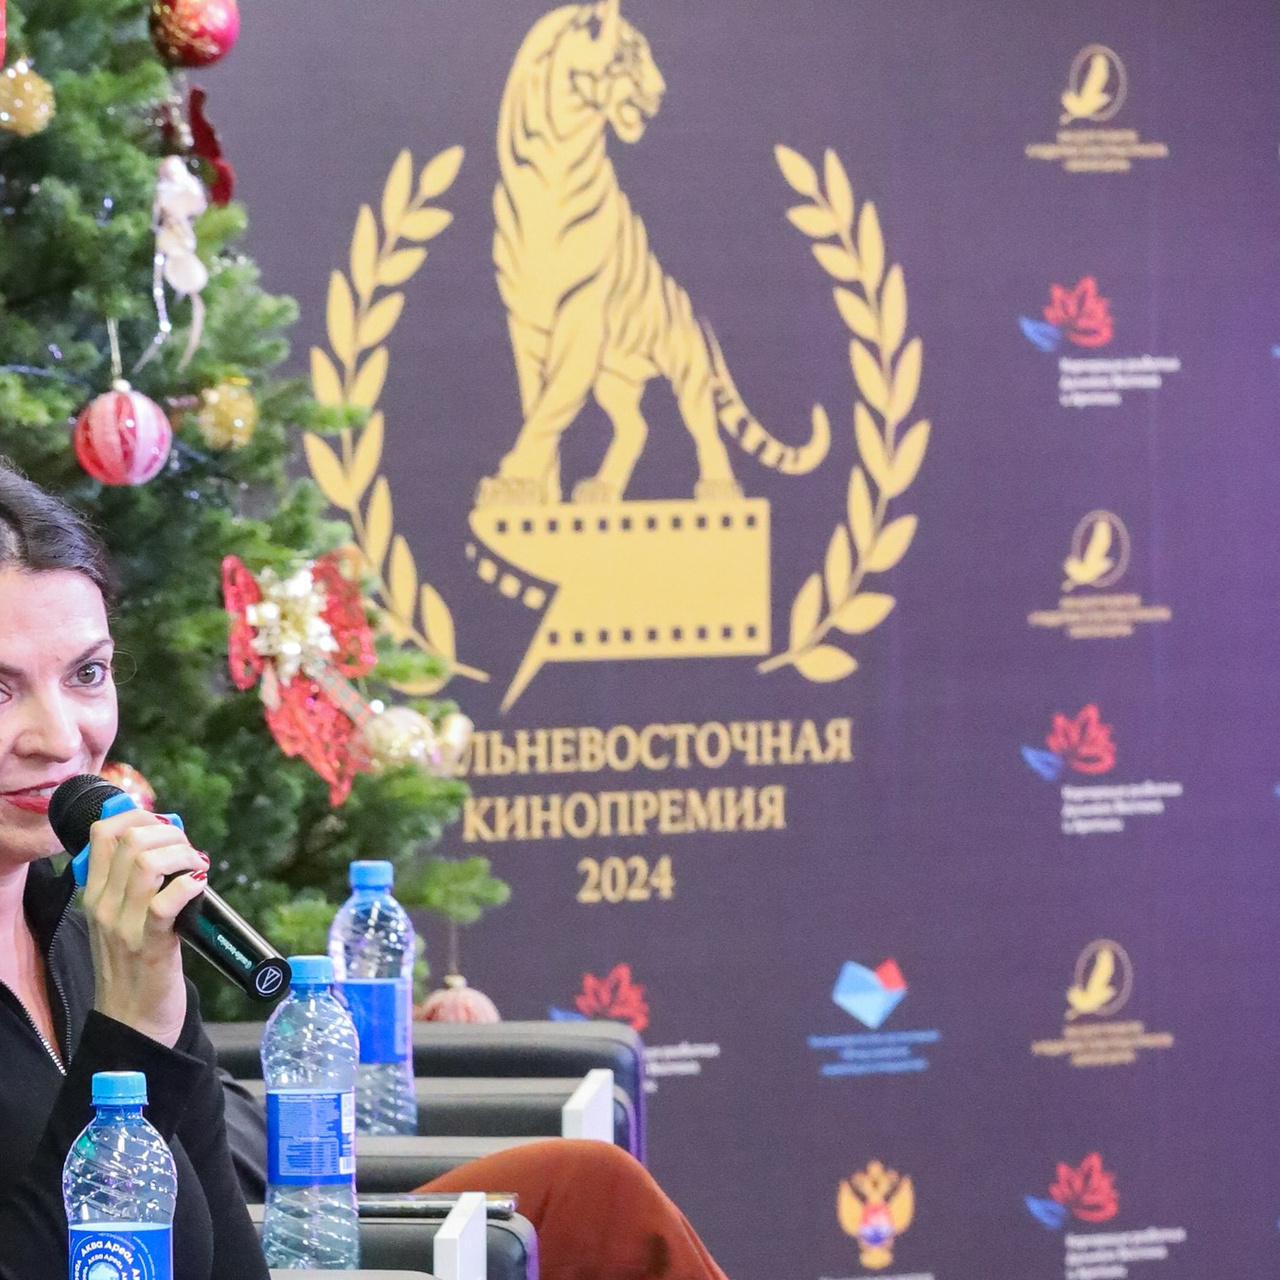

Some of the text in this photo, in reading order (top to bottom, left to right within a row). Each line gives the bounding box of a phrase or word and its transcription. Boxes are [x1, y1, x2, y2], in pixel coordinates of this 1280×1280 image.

[454, 717, 853, 777] ЛЬНЕВОСТОЧНАЯ
[462, 785, 787, 843] КИНОПРЕМИЯ
[576, 855, 675, 904] 2024
